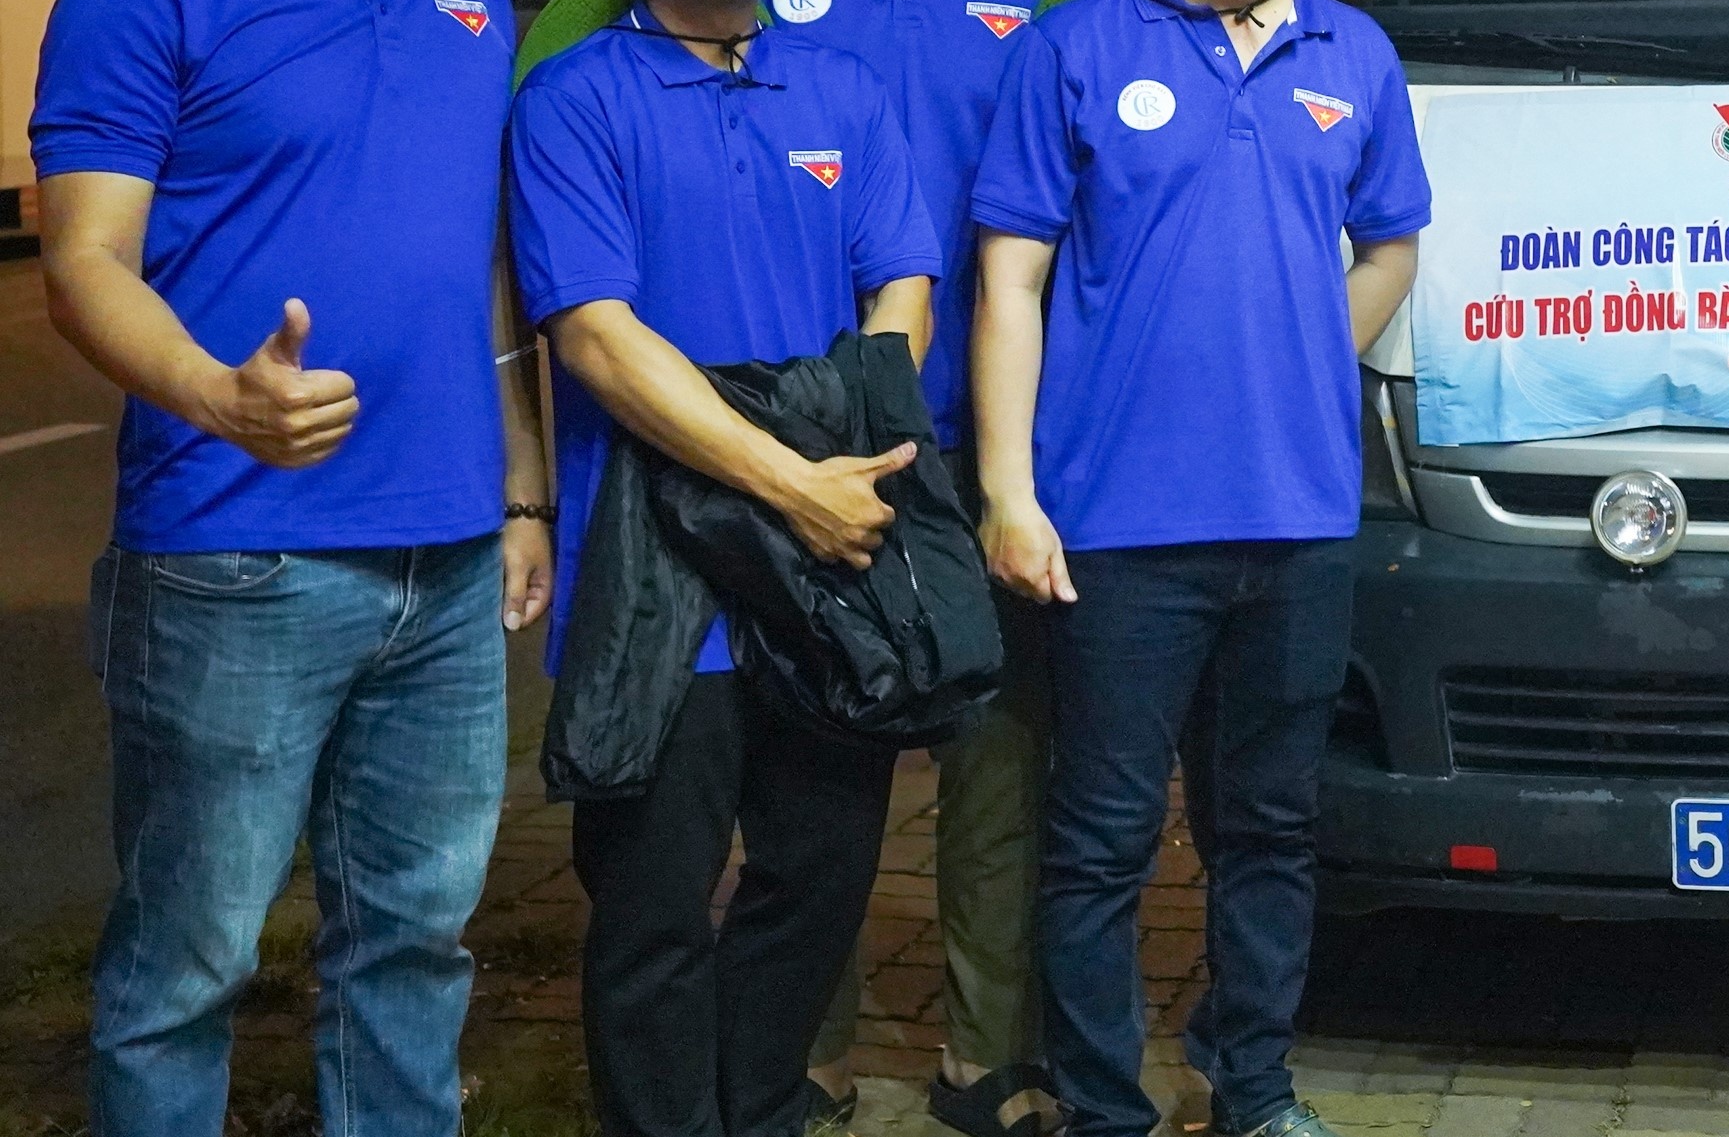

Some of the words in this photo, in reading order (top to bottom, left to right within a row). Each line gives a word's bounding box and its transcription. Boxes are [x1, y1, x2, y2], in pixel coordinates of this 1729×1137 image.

[1500, 226, 1581, 271] ĐOÀN
[1592, 222, 1675, 266] CÔNG
[1464, 294, 1525, 342] CỨU
[1534, 289, 1593, 342] TRỢ
[1602, 280, 1686, 333] ĐỒNG
